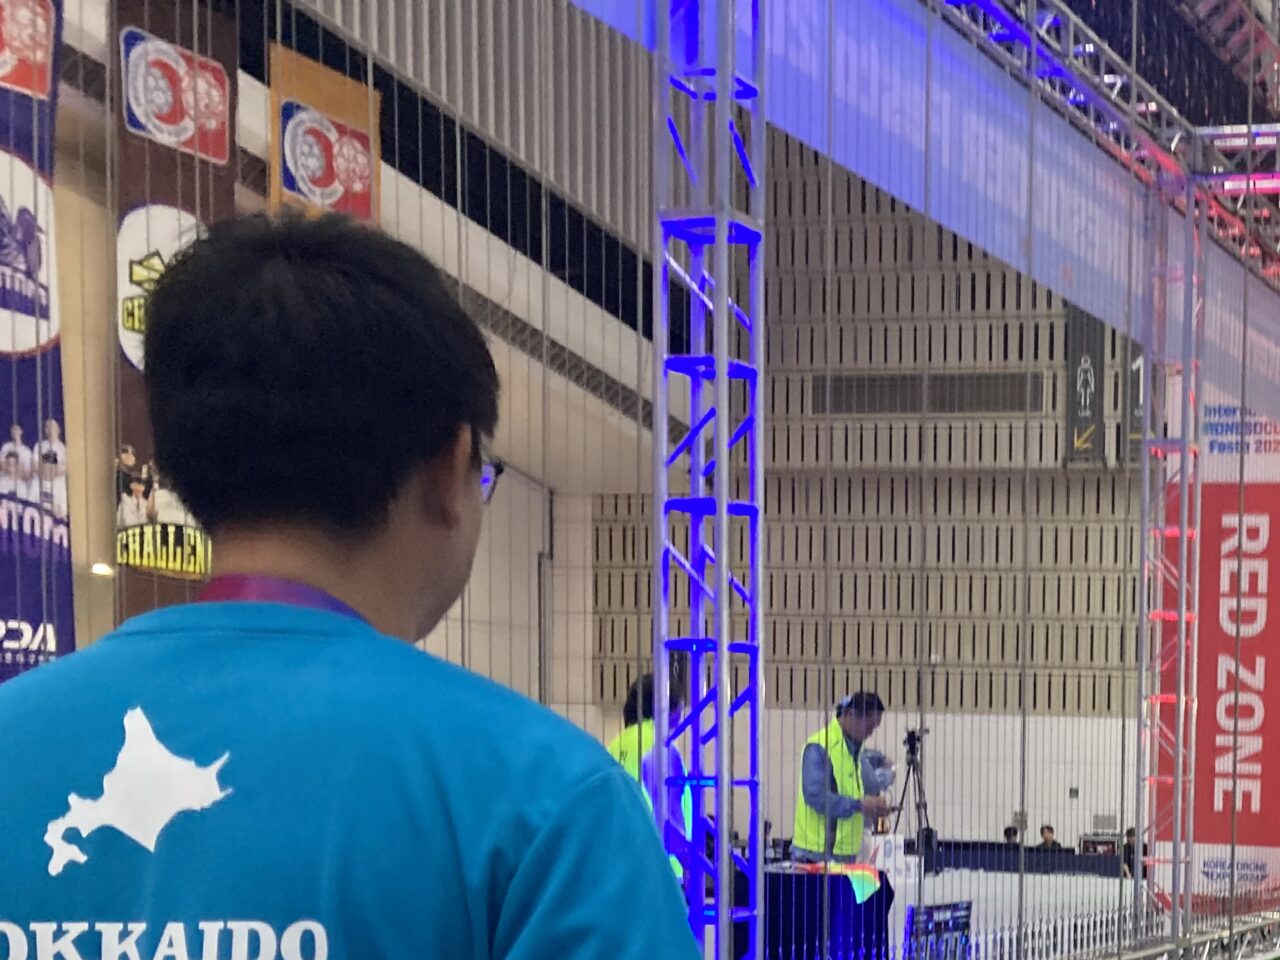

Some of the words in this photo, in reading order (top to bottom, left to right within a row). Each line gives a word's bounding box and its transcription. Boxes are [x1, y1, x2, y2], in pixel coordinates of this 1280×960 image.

[117, 523, 213, 576] CHALLEN
[1218, 512, 1270, 639] RED
[1213, 654, 1266, 814] ZONE
